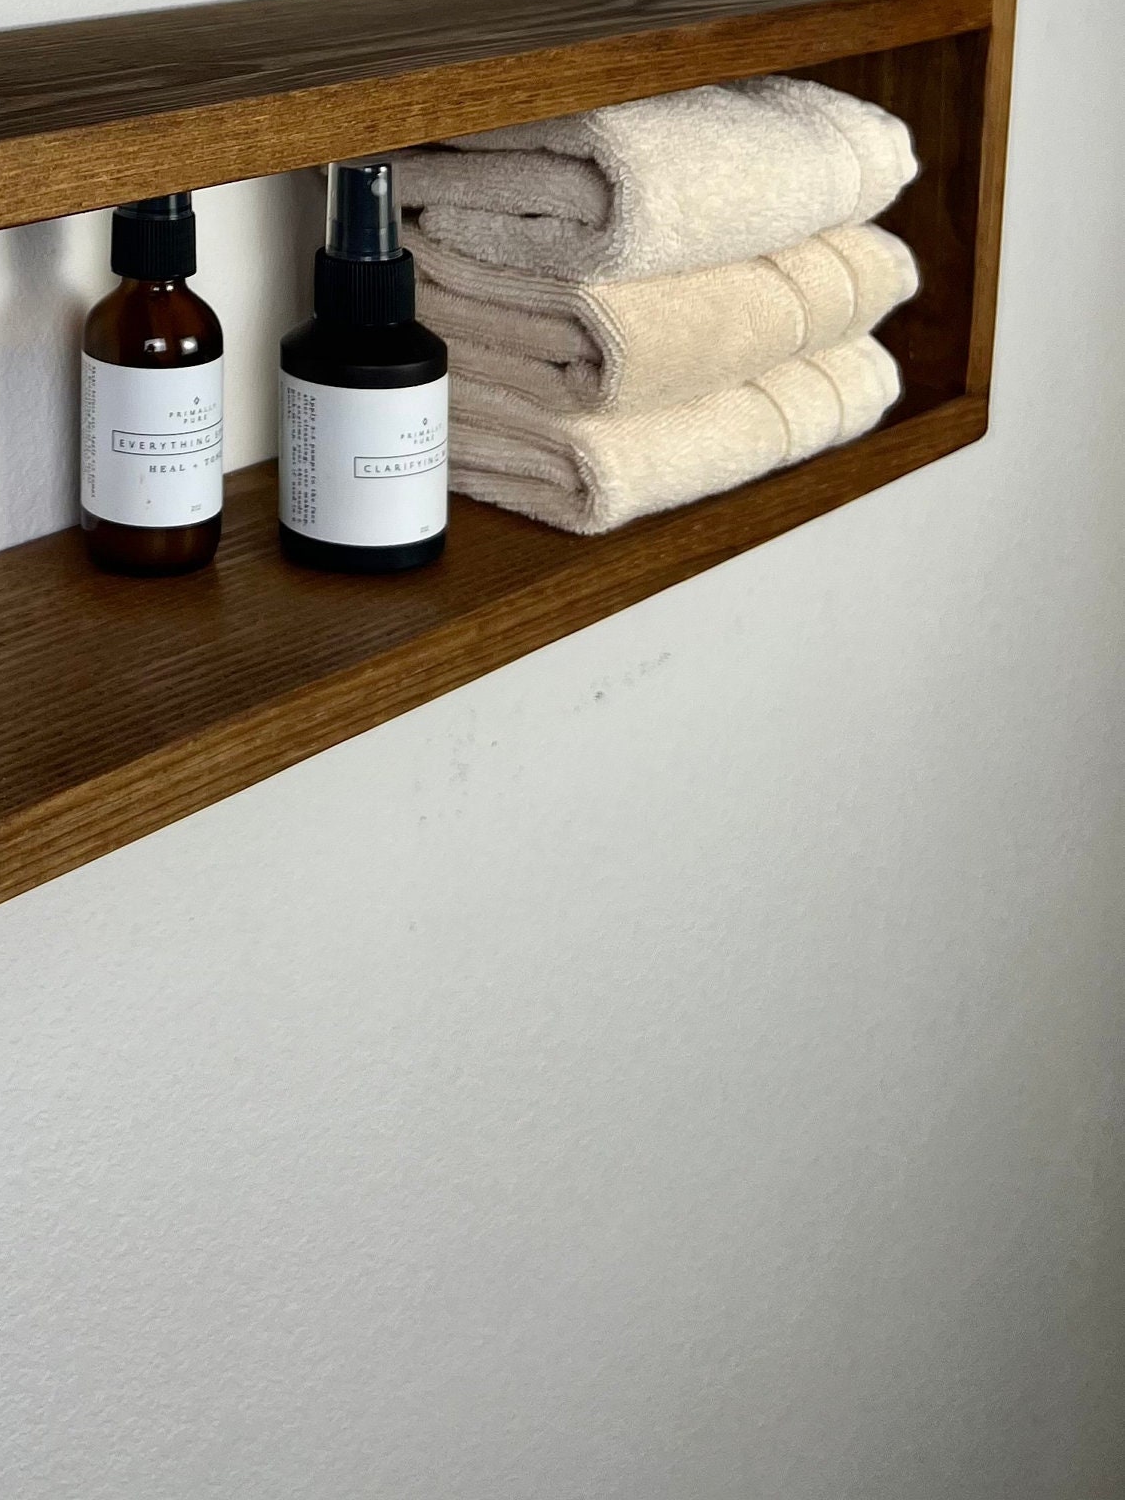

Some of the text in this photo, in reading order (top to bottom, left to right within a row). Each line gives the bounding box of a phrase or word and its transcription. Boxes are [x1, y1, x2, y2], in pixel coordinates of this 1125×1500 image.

[183, 414, 208, 424] PURE
[119, 435, 211, 450] EVERYTHING
[149, 464, 186, 473] HEAL
[363, 454, 440, 474] CLARIFYING
